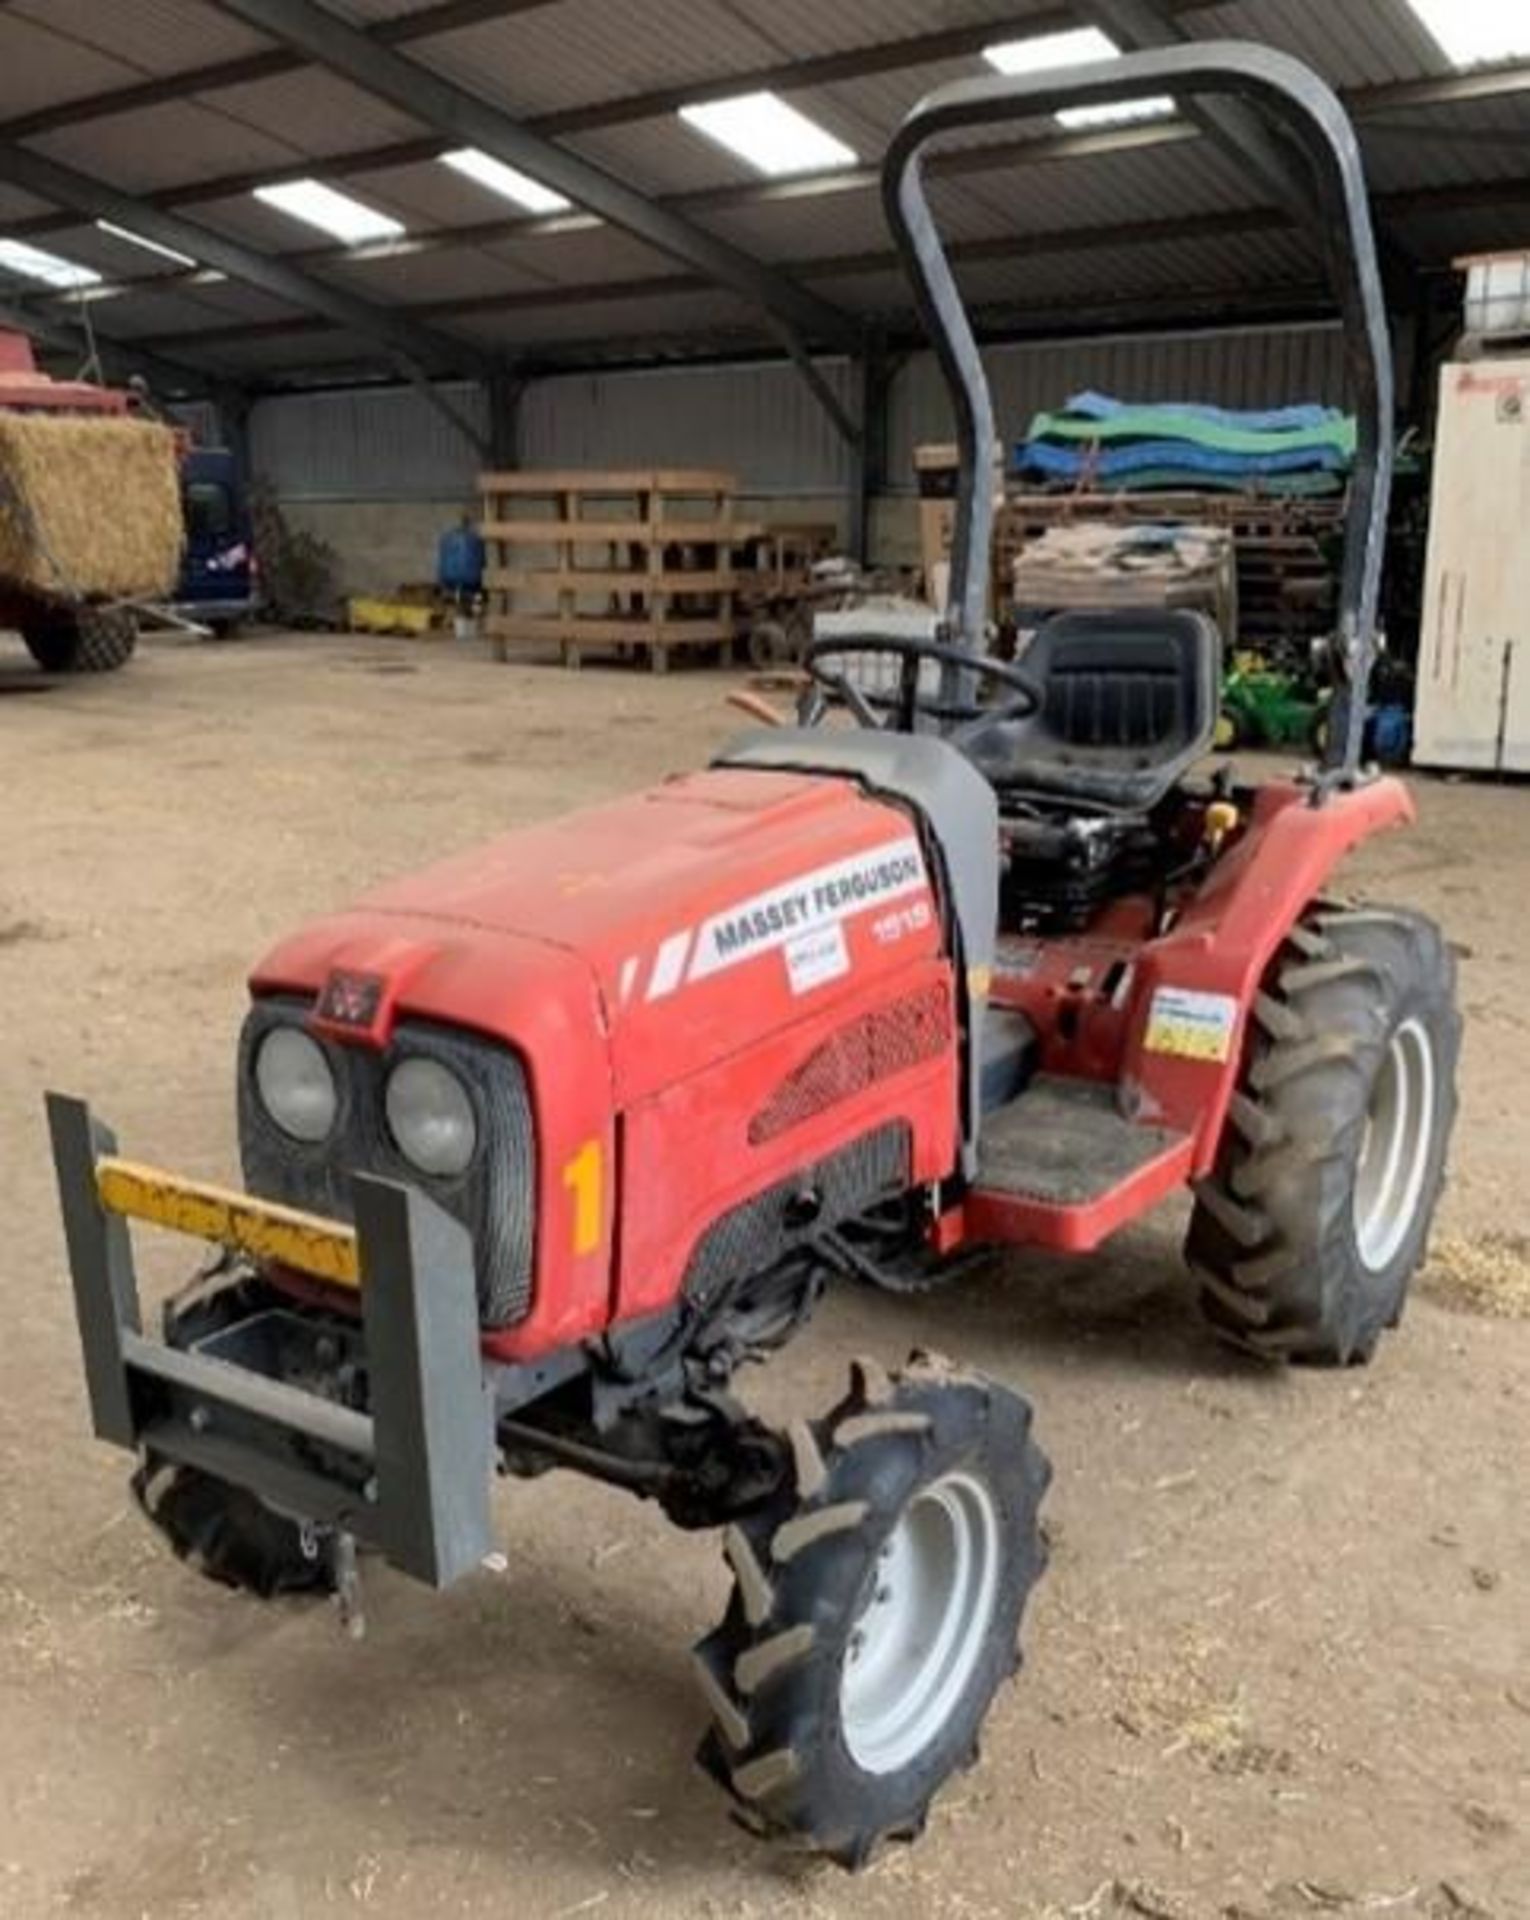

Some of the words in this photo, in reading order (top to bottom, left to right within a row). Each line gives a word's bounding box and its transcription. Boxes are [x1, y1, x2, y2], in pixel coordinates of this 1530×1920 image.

[714, 893, 809, 956] MASSEY
[812, 854, 919, 912] FERGUSON
[563, 1139, 604, 1255] 1
